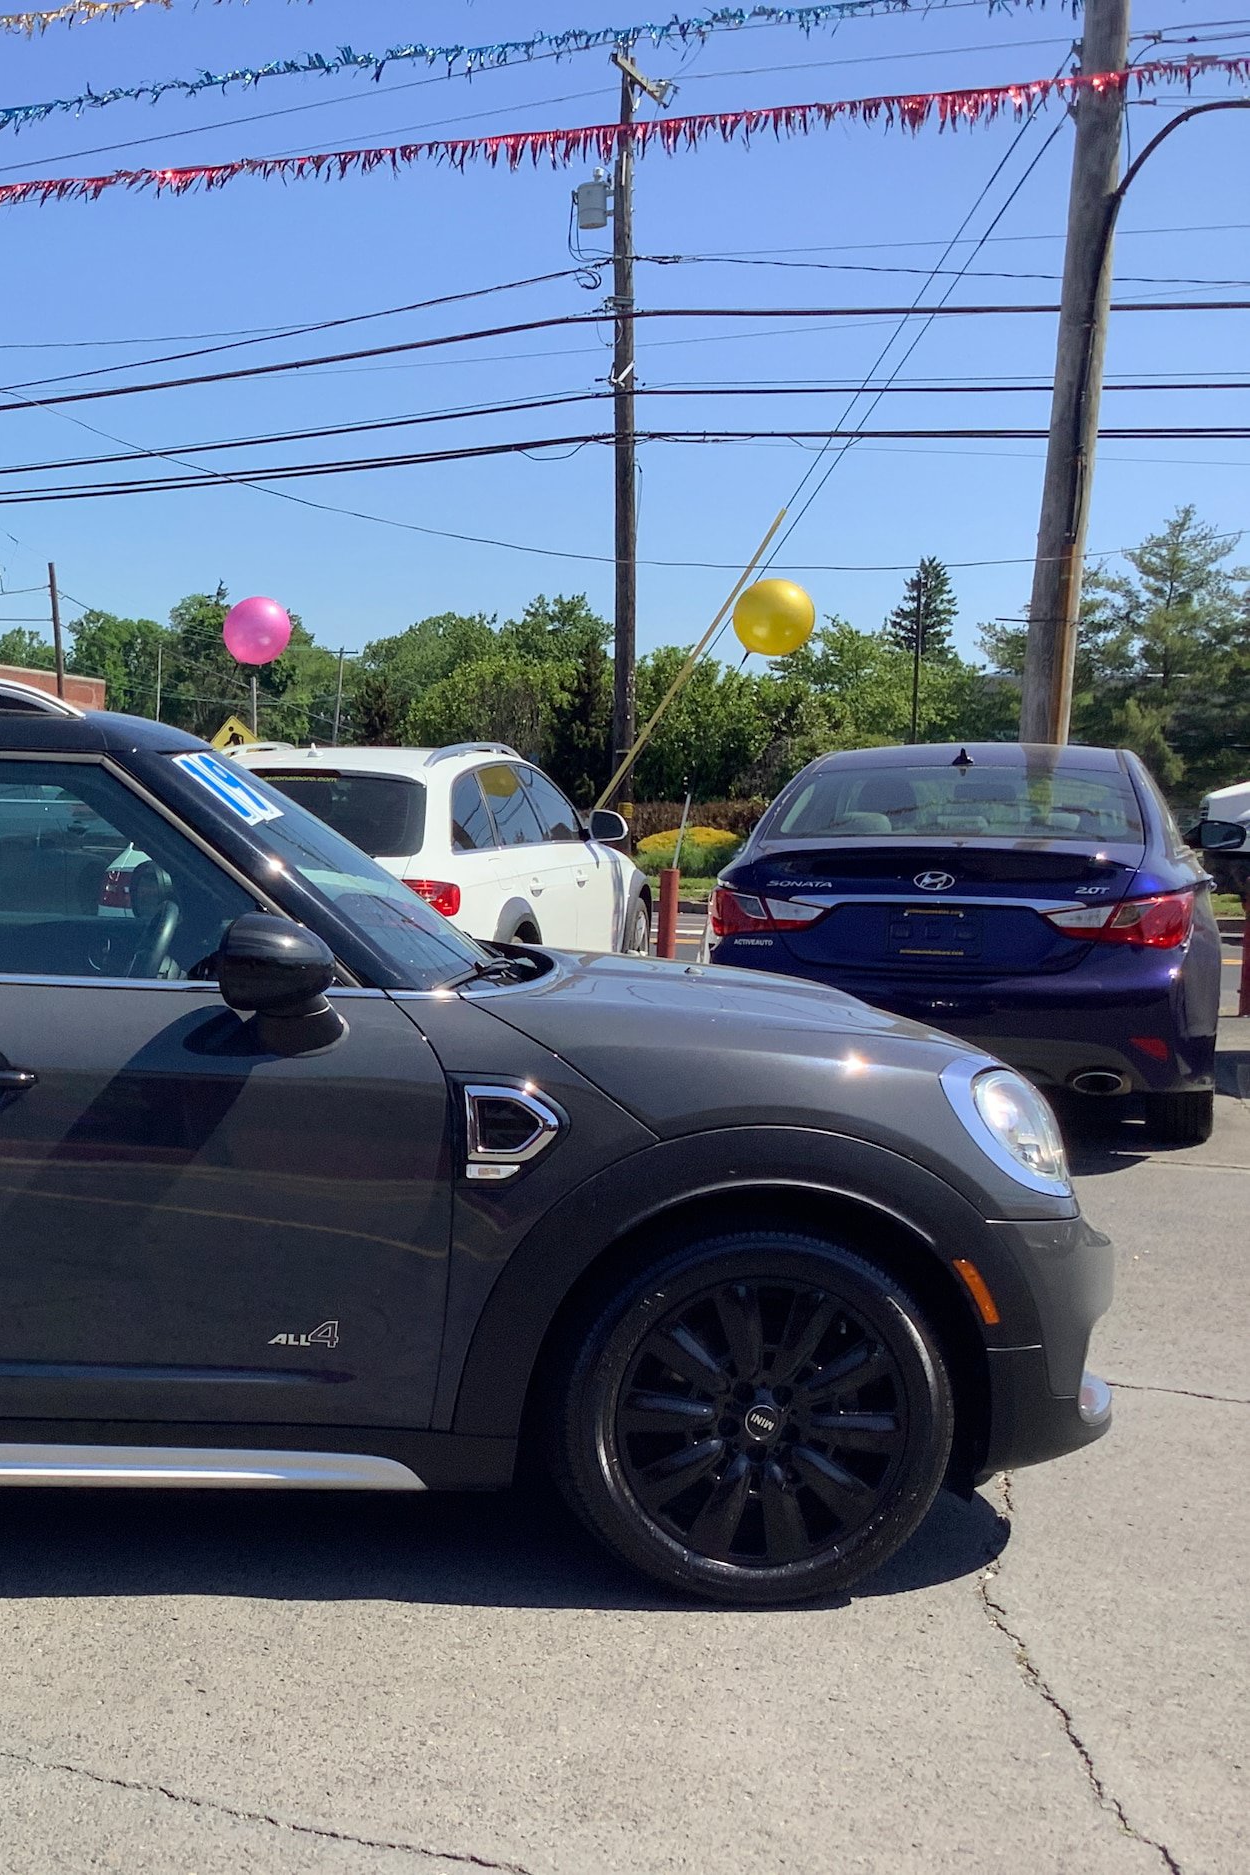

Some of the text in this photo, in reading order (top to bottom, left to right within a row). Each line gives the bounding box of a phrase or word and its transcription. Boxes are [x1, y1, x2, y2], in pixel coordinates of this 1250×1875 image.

[179, 754, 269, 819] 19
[766, 880, 832, 888] SONATA
[750, 1413, 775, 1432] MINI
